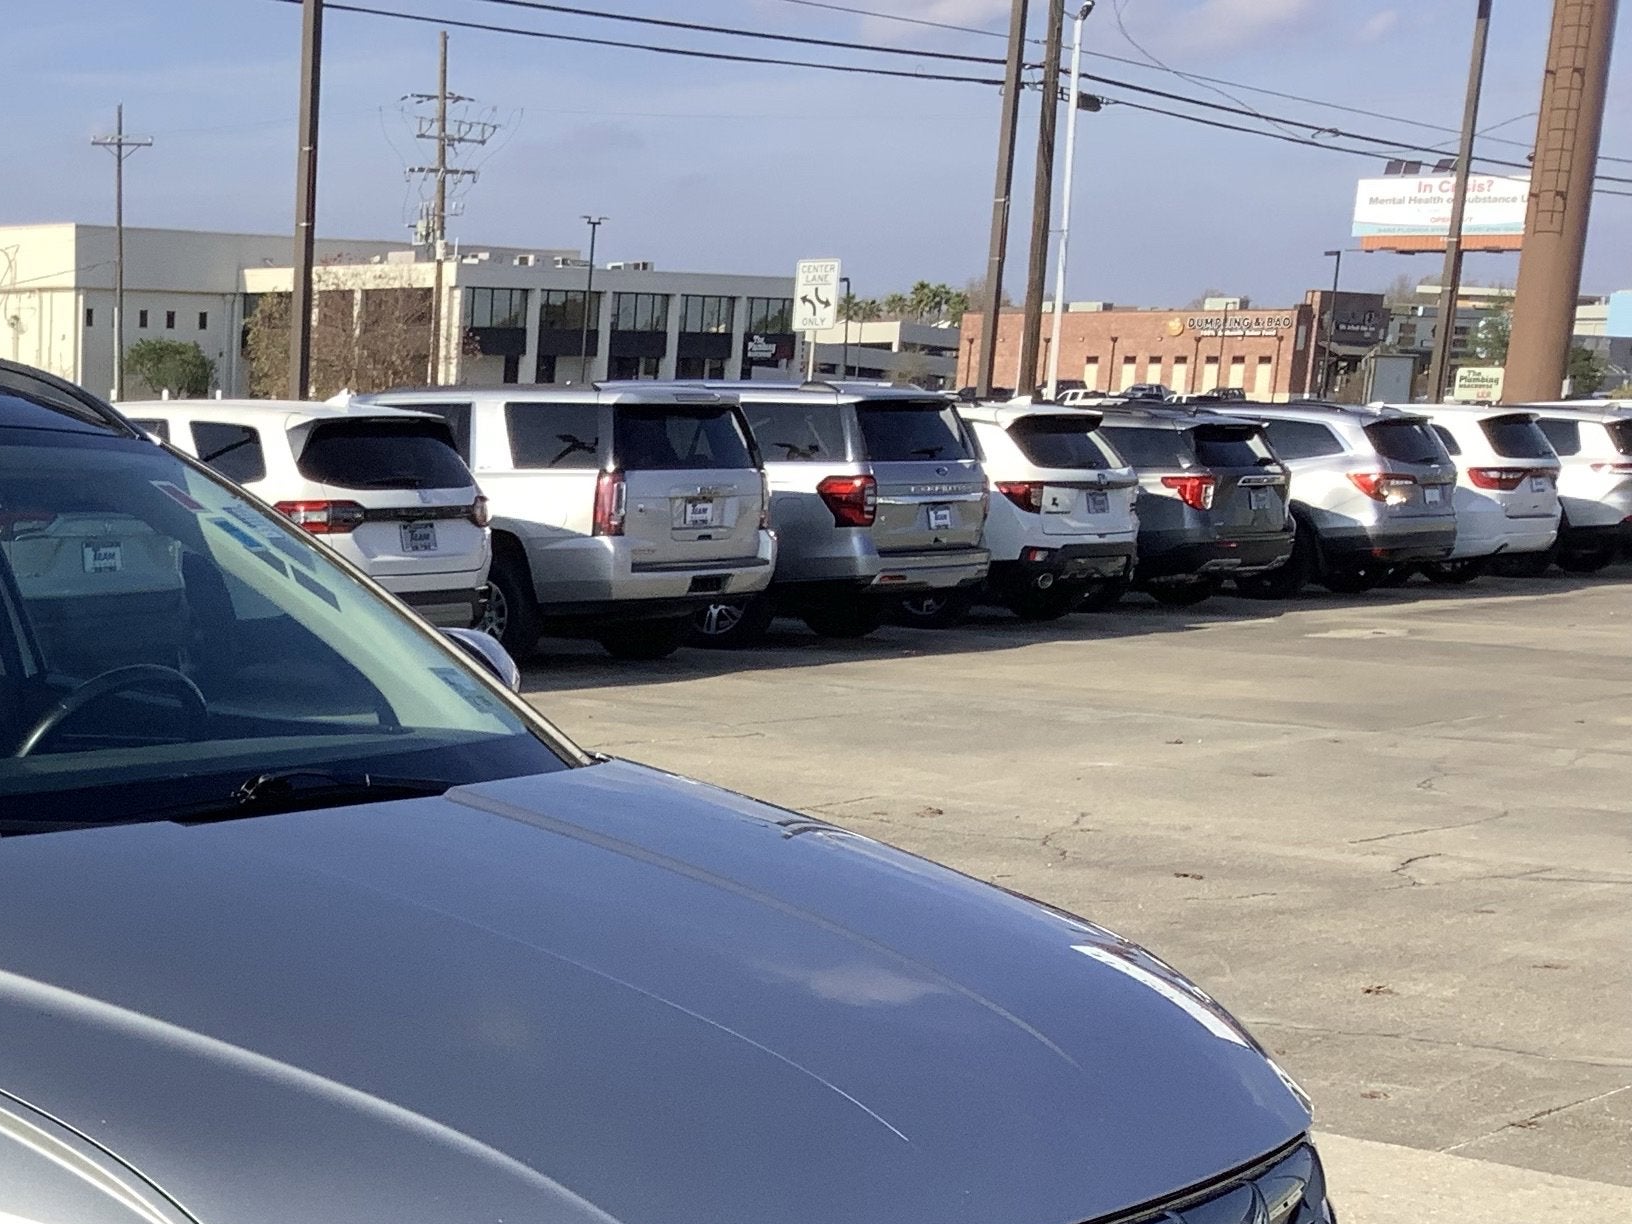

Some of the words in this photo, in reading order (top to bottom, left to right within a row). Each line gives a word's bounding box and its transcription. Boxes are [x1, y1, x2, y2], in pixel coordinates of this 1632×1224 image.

[1418, 181, 1433, 194] In
[1369, 197, 1405, 206] Mental
[1408, 196, 1444, 205] Health
[1464, 194, 1518, 204] ubstance
[801, 264, 836, 274] CENTER
[805, 274, 829, 283] LANE
[802, 318, 826, 327] ONLY
[1266, 317, 1292, 328] BAO
[1459, 375, 1500, 385] Plumbing
